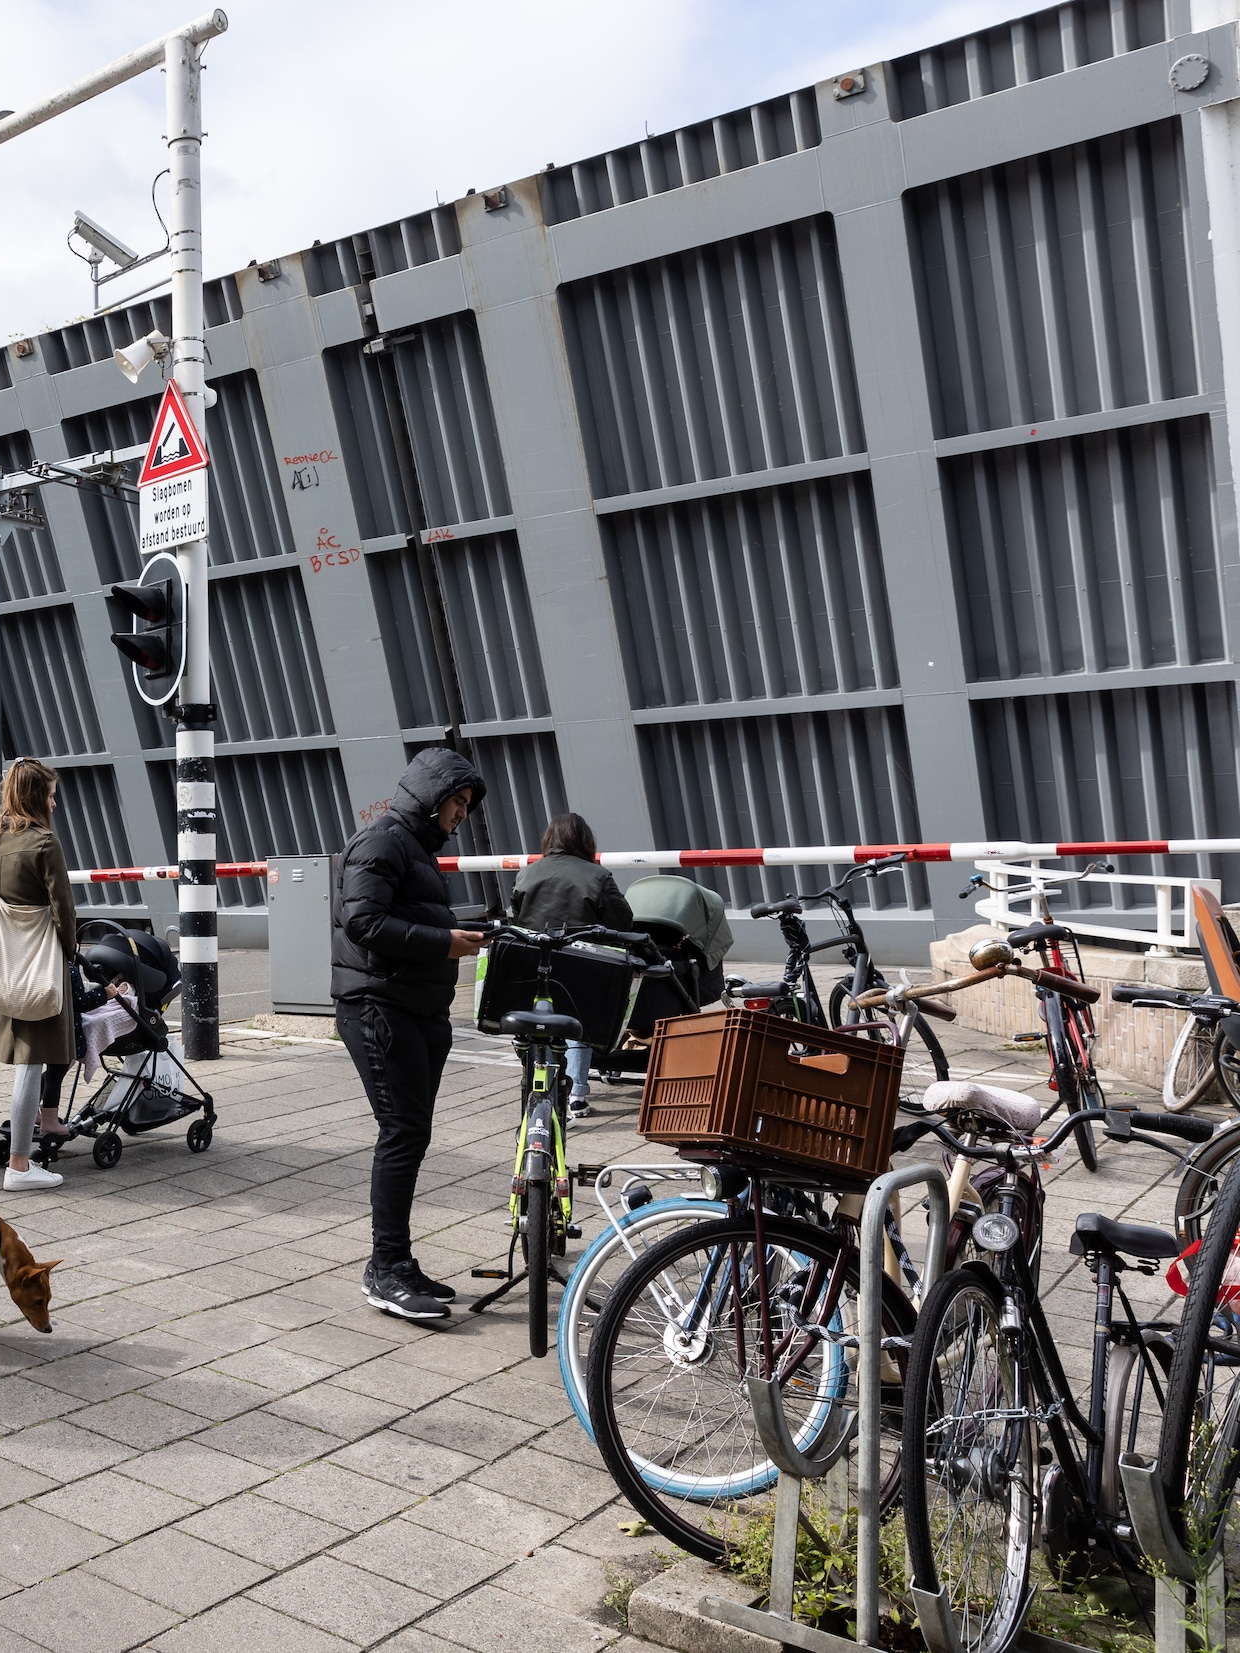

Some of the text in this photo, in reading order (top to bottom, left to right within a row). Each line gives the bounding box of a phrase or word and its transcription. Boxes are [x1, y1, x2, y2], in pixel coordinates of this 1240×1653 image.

[152, 479, 192, 503] Slagbomen
[154, 503, 191, 524] worden op
[141, 517, 205, 549] afstand bestuurd
